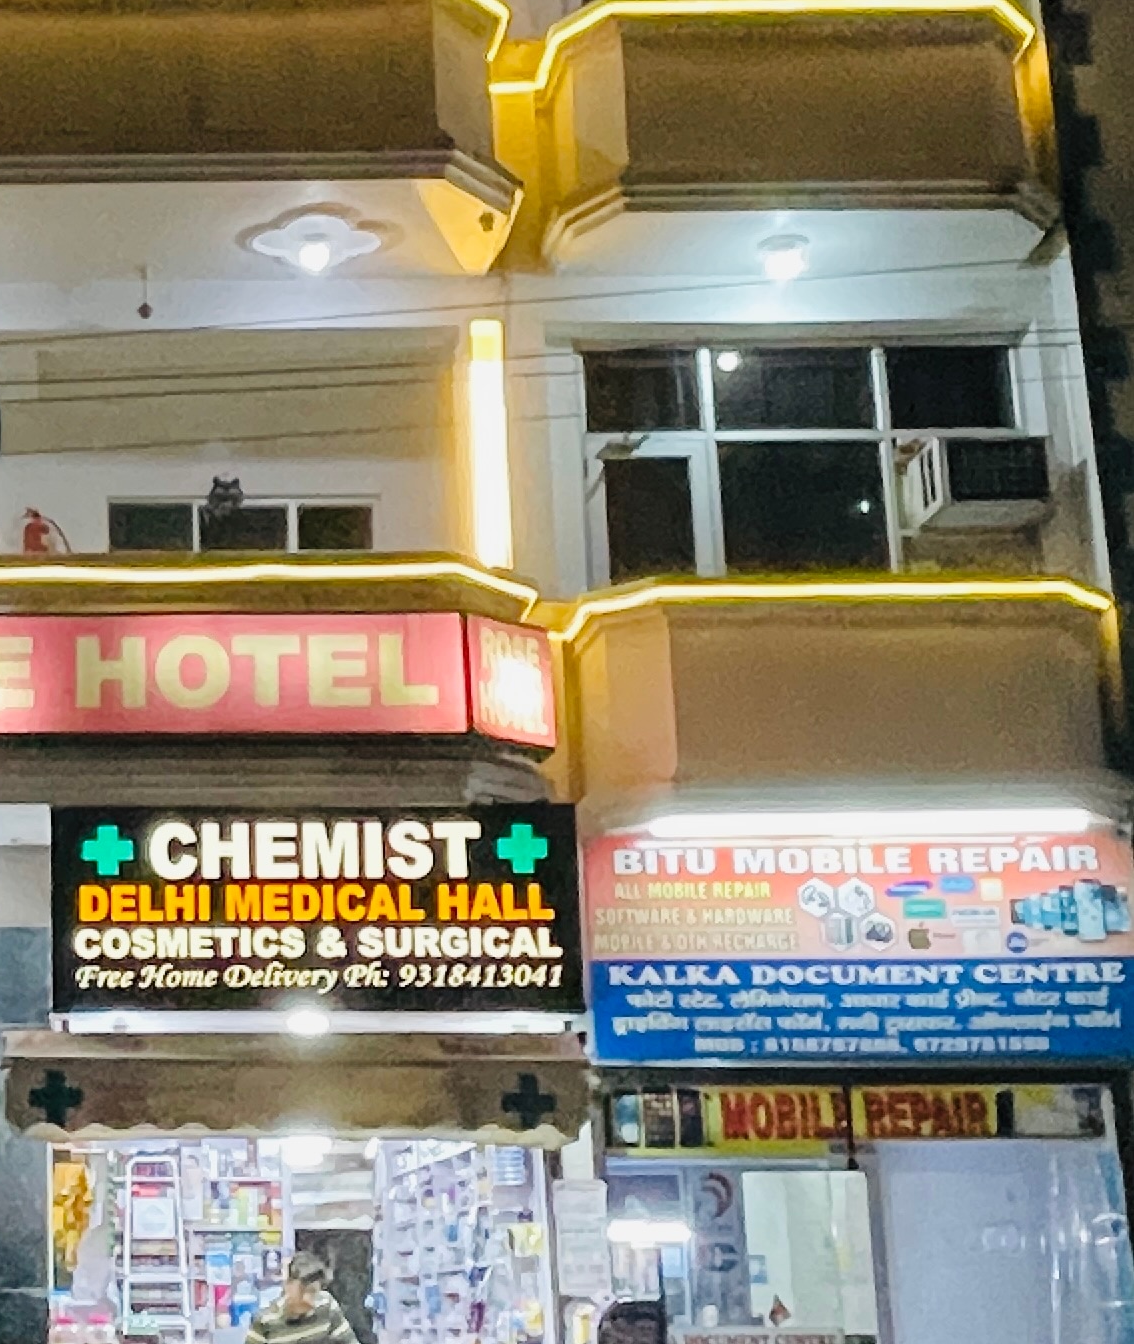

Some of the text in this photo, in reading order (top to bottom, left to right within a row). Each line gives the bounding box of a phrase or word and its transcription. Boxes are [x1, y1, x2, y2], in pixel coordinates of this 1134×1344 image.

[75, 632, 439, 709] HOTEL
[148, 820, 482, 881] CHEMIST
[613, 844, 1098, 875] BITU MOBILE REPAIR
[77, 882, 556, 922] DELHI MEDICAL HALL
[647, 881, 707, 900] MOBILE
[712, 881, 771, 900] REPAIR
[595, 908, 681, 926] SOFTWARE
[702, 908, 795, 926] HARDWARE
[72, 926, 564, 959] COSMETICS & SURGICAL
[74, 964, 134, 989] Free
[138, 962, 218, 989] Home
[222, 961, 340, 995] Delivery
[398, 962, 563, 988] 9318413041
[608, 962, 1126, 987] KALKA DOCUMENT CENTRE
